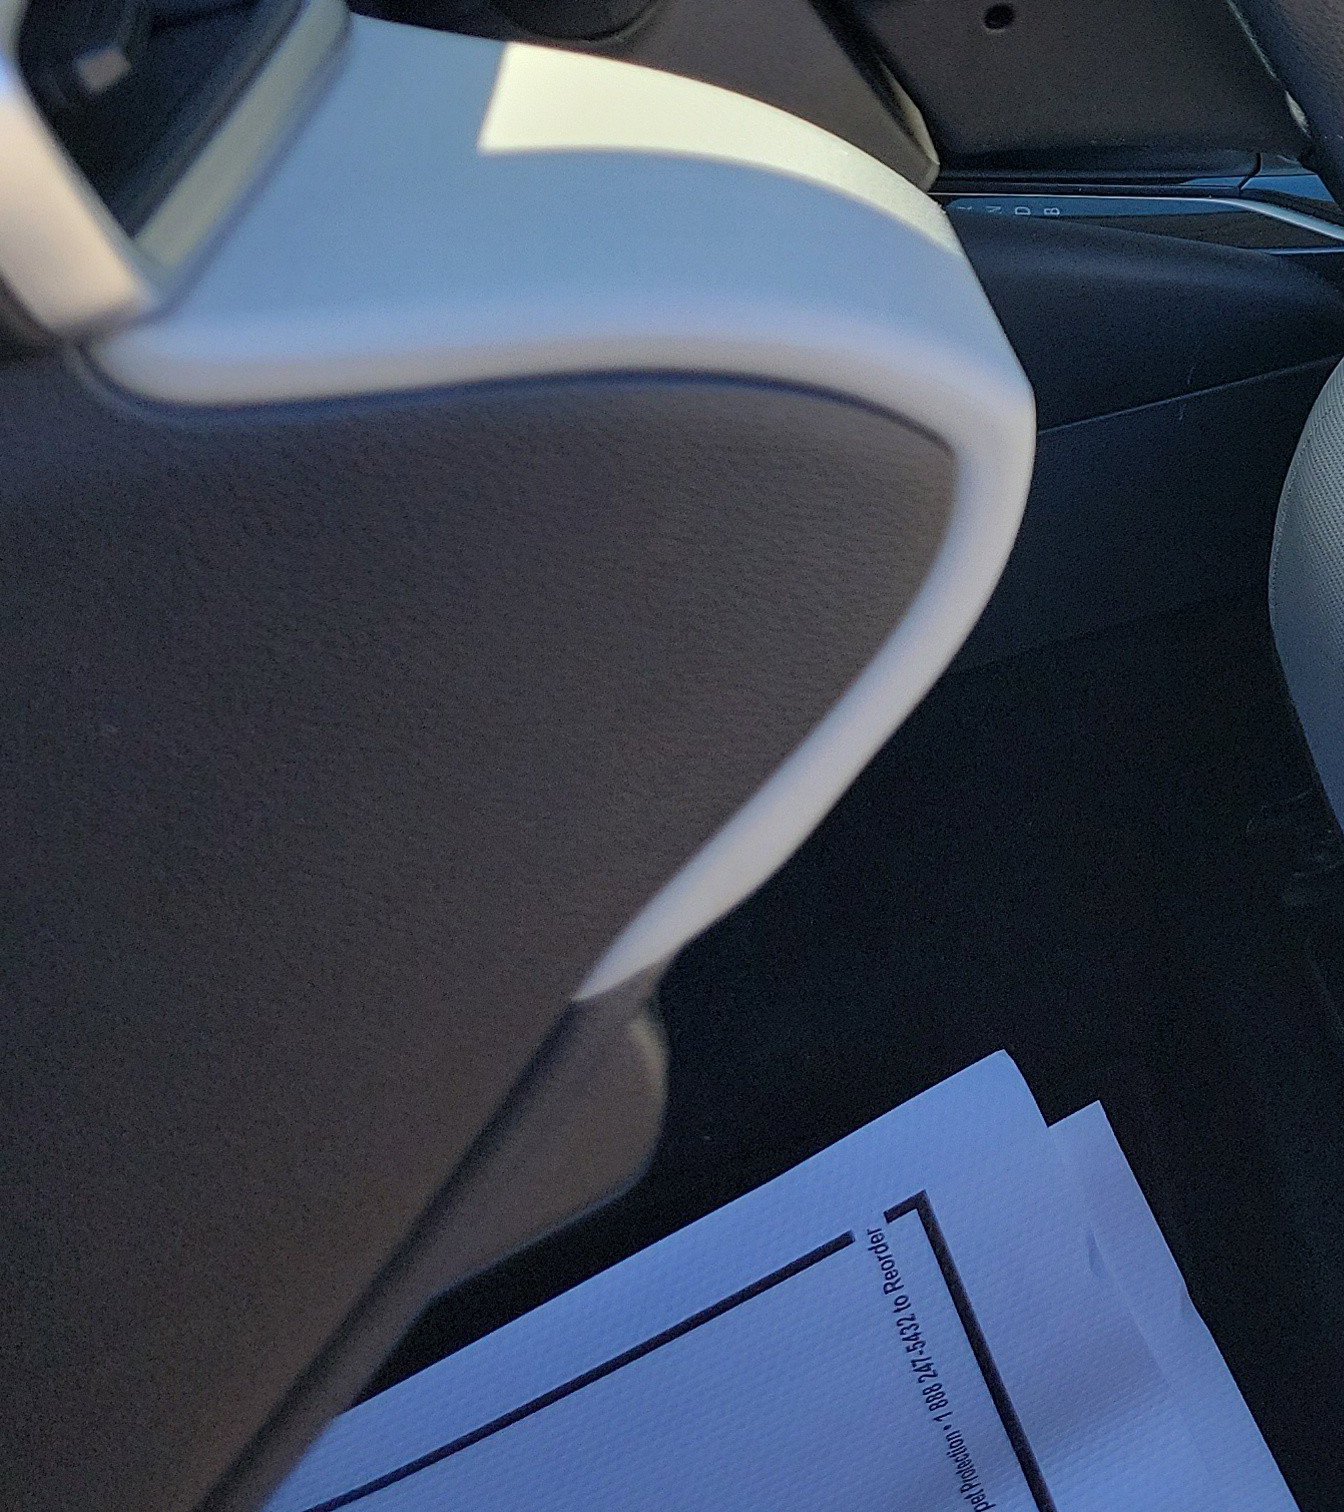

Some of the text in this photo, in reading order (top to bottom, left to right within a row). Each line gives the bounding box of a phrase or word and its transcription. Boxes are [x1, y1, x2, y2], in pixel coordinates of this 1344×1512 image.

[866, 1227, 905, 1295] Reorder
[893, 1294, 912, 1314] to
[896, 1313, 939, 1384] 247-5432
[922, 1382, 949, 1412] 888
[946, 1429, 981, 1494] Protection
